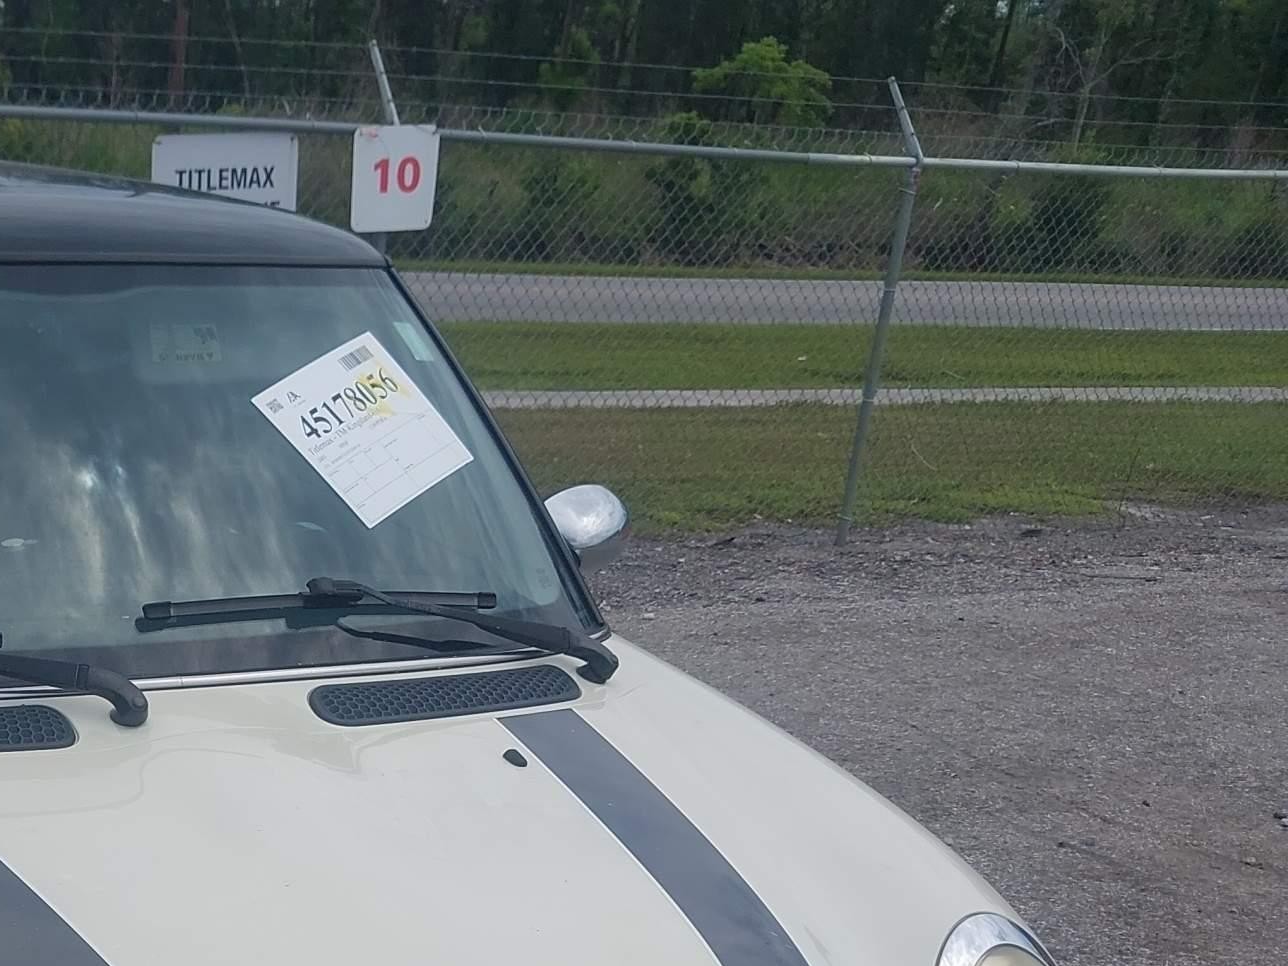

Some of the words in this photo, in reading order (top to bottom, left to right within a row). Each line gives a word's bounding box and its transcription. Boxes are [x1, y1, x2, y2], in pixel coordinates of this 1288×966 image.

[175, 166, 275, 191] TITLEMAX
[373, 156, 422, 194] 10
[300, 367, 399, 439] 45178056
